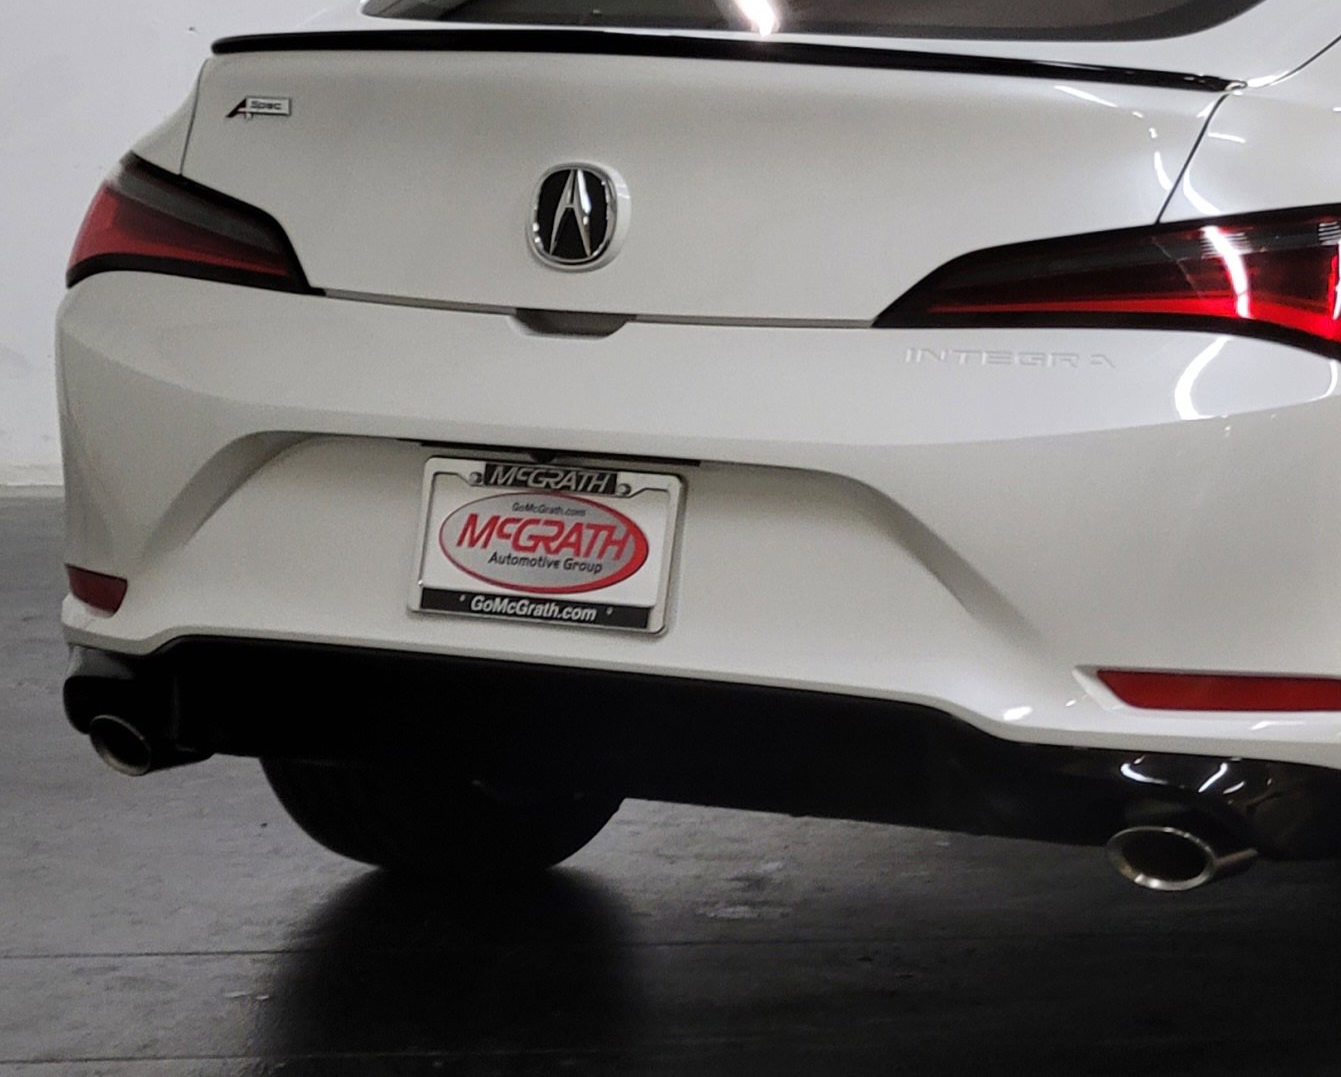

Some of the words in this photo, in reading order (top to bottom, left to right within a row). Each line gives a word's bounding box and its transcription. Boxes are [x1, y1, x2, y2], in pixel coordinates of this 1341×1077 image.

[905, 347, 1116, 369] INTEGRA
[512, 502, 586, 517] GoMcGrath.com
[488, 552, 560, 569] Automotive
[563, 557, 603, 575] Group
[471, 595, 597, 622] GoMcGrath.com
